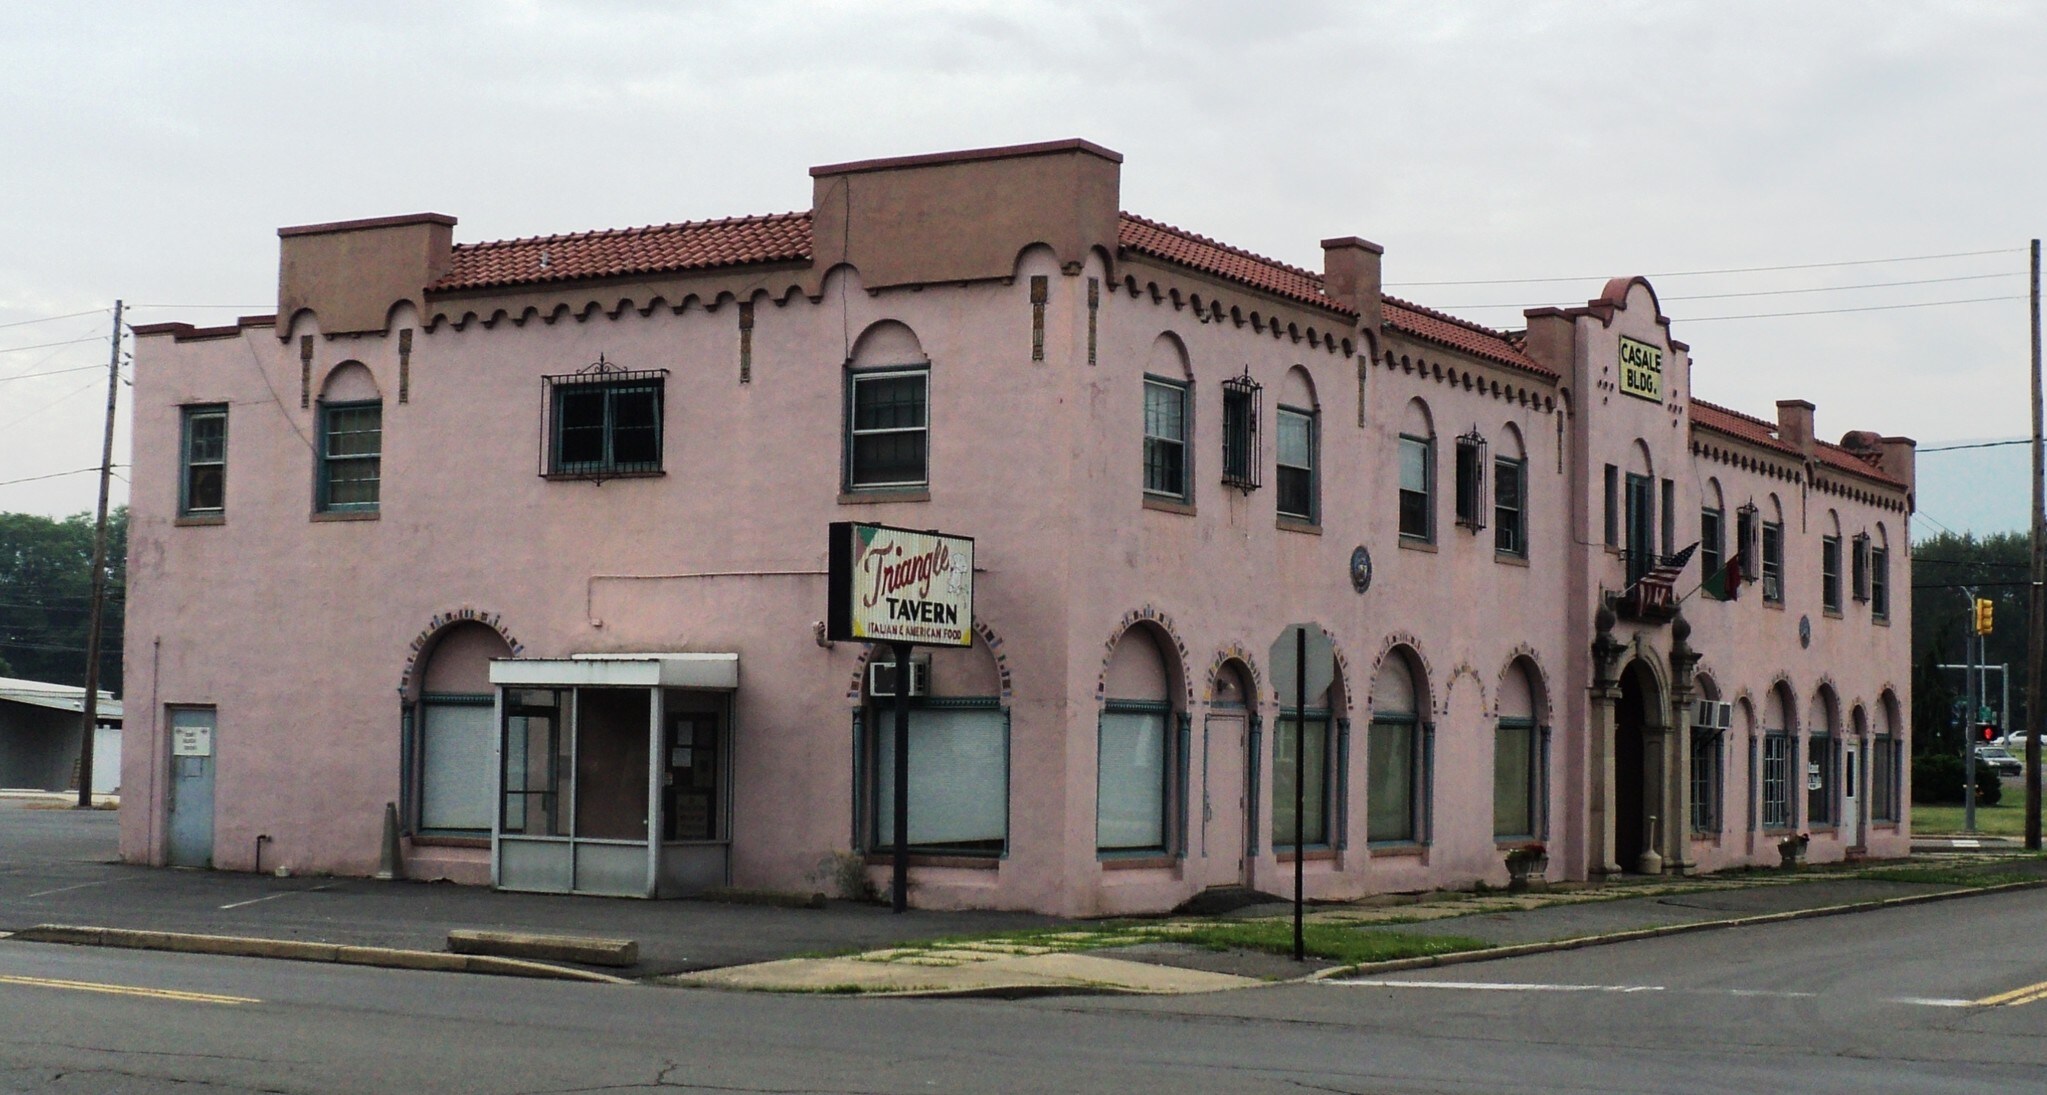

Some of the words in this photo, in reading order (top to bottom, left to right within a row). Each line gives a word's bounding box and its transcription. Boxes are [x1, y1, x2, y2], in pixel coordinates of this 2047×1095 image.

[1621, 343, 1661, 373] CASALE
[1627, 369, 1657, 394] BLDG.
[863, 539, 949, 608] Triangle
[886, 598, 957, 625] TAVERN
[868, 622, 897, 635] ITALIAN
[906, 625, 941, 639] AMERICAN
[944, 628, 961, 640] FOOD
